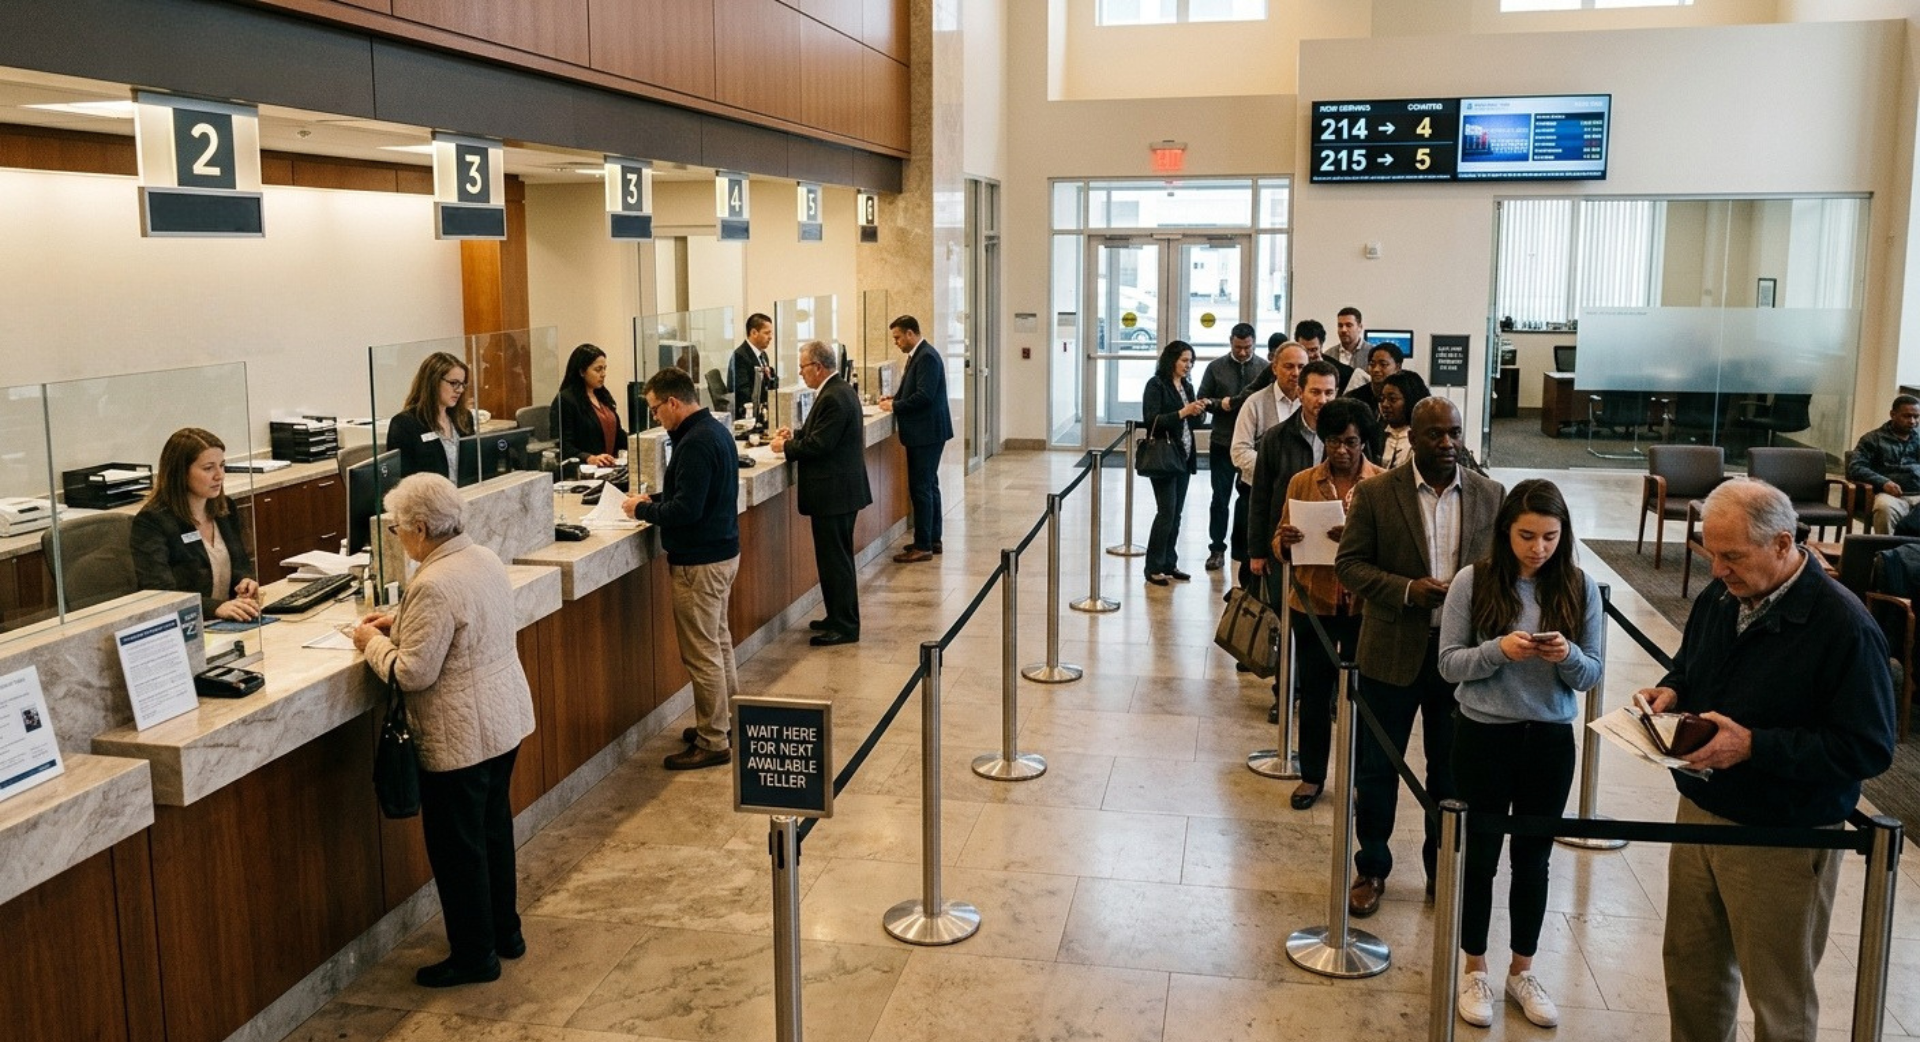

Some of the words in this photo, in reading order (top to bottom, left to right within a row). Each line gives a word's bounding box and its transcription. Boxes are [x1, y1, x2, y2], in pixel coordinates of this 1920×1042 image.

[1320, 117, 1369, 141] 214
[1416, 116, 1433, 139] 4
[190, 122, 222, 176] 2
[1319, 148, 1368, 172] 215
[1414, 147, 1432, 171] 5
[464, 154, 483, 194] 3
[626, 173, 639, 205] 3
[730, 185, 742, 213] 4
[808, 193, 816, 215] 5
[746, 725, 779, 738] WAIT
[783, 726, 817, 741] HERE
[750, 740, 776, 754] FOR
[779, 742, 814, 757] NEXT
[747, 757, 817, 773] AVAILABLE
[758, 773, 806, 788] TELLER
